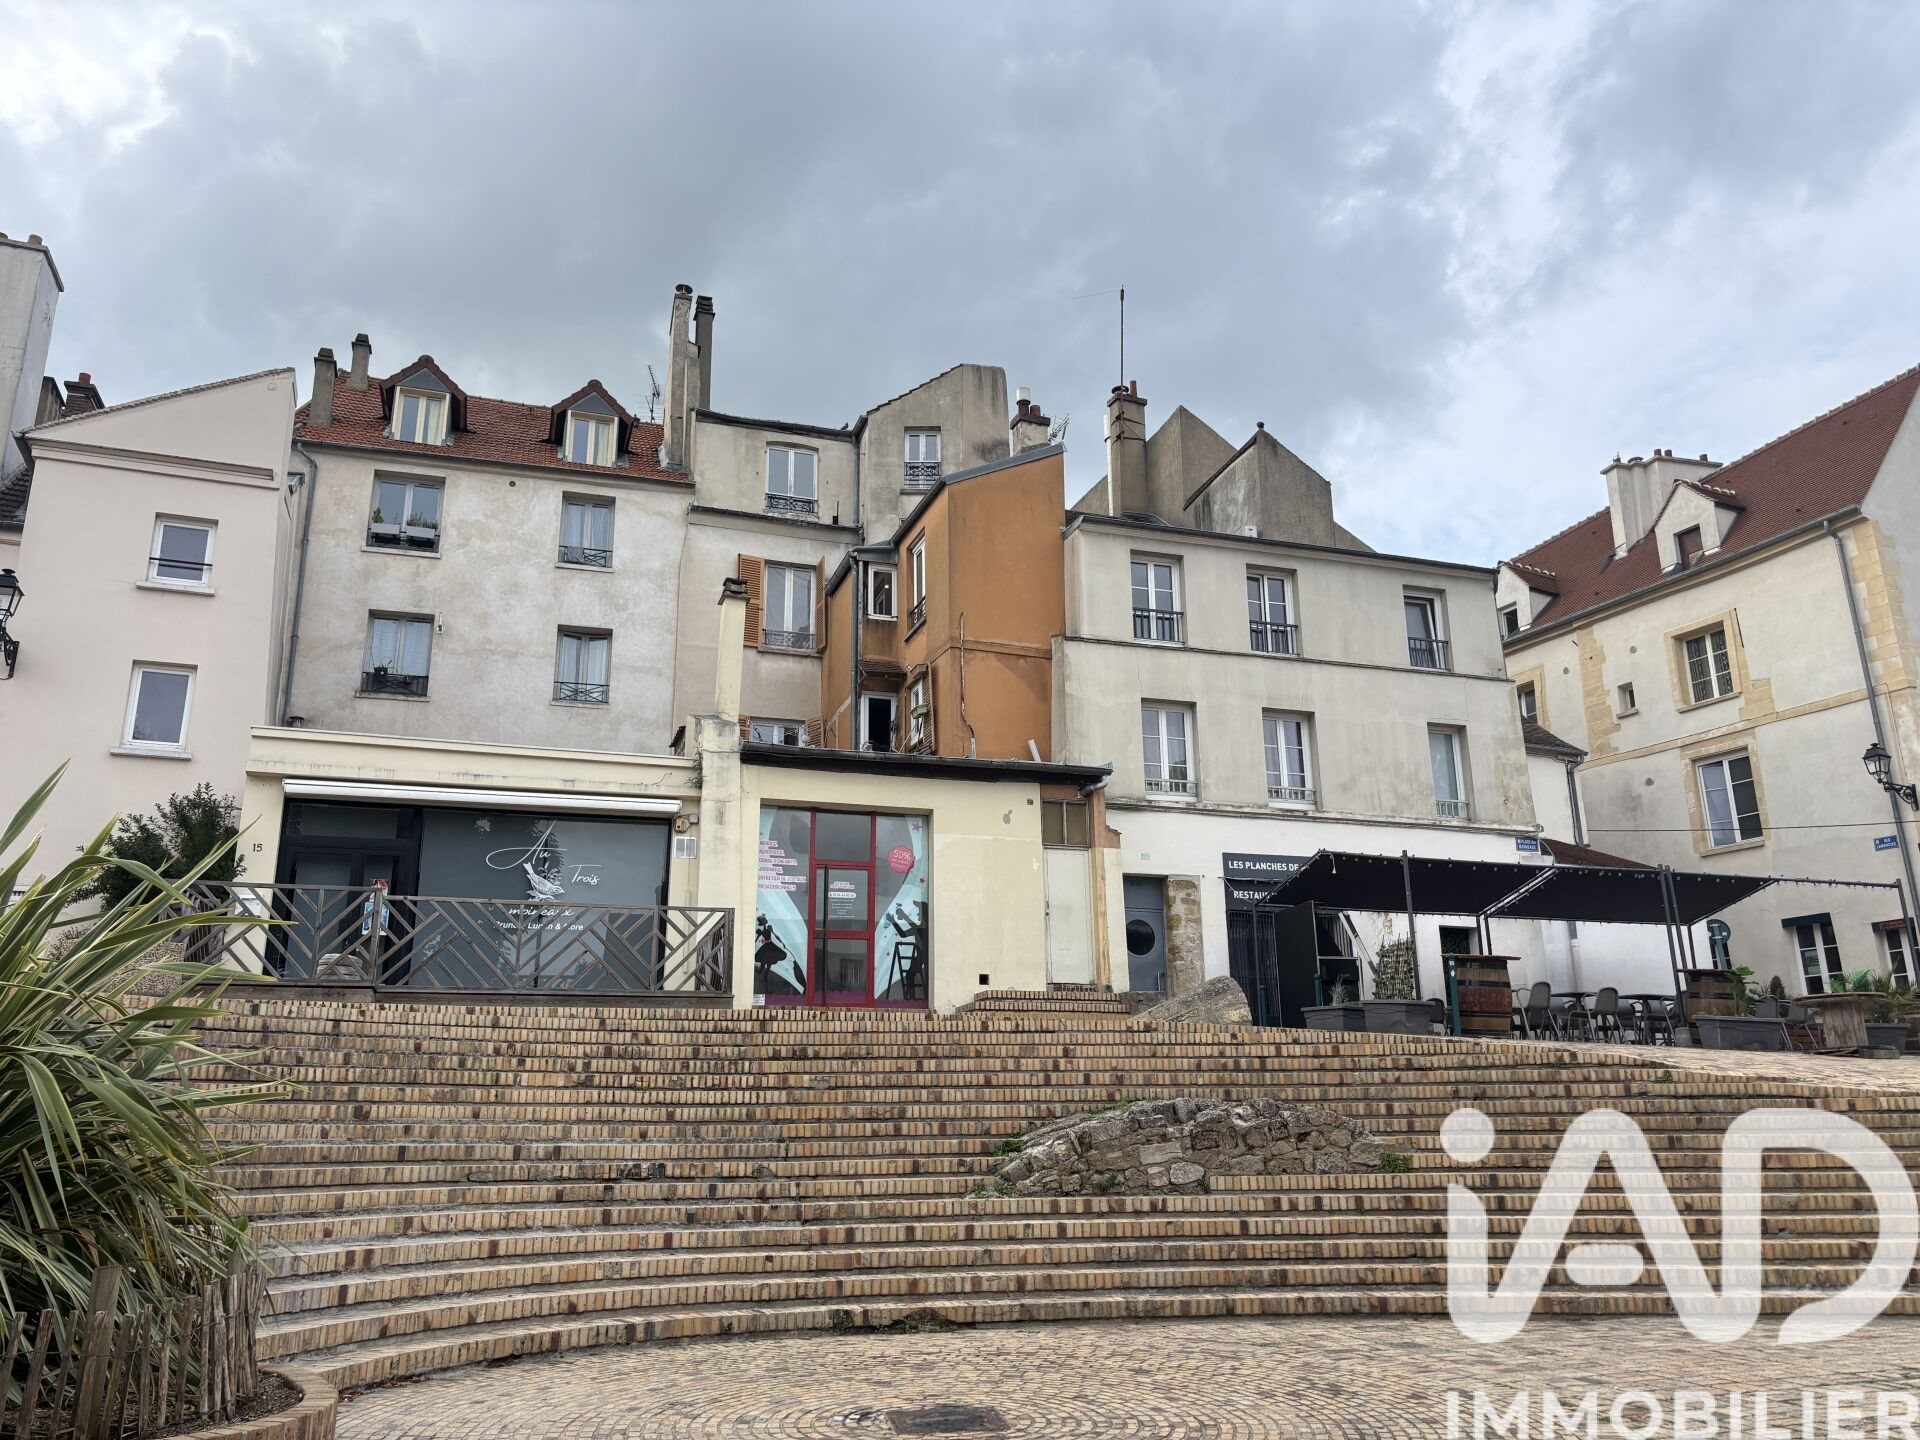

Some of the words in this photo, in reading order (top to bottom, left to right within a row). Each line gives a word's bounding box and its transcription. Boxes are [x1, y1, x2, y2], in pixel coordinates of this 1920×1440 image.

[253, 844, 263, 852] 15
[486, 819, 568, 869] Au
[893, 849, 911, 860] 50%
[1228, 860, 1244, 869] LES
[1245, 861, 1287, 871] PLANCHES
[568, 865, 602, 885] Trois
[508, 906, 575, 916] moineax
